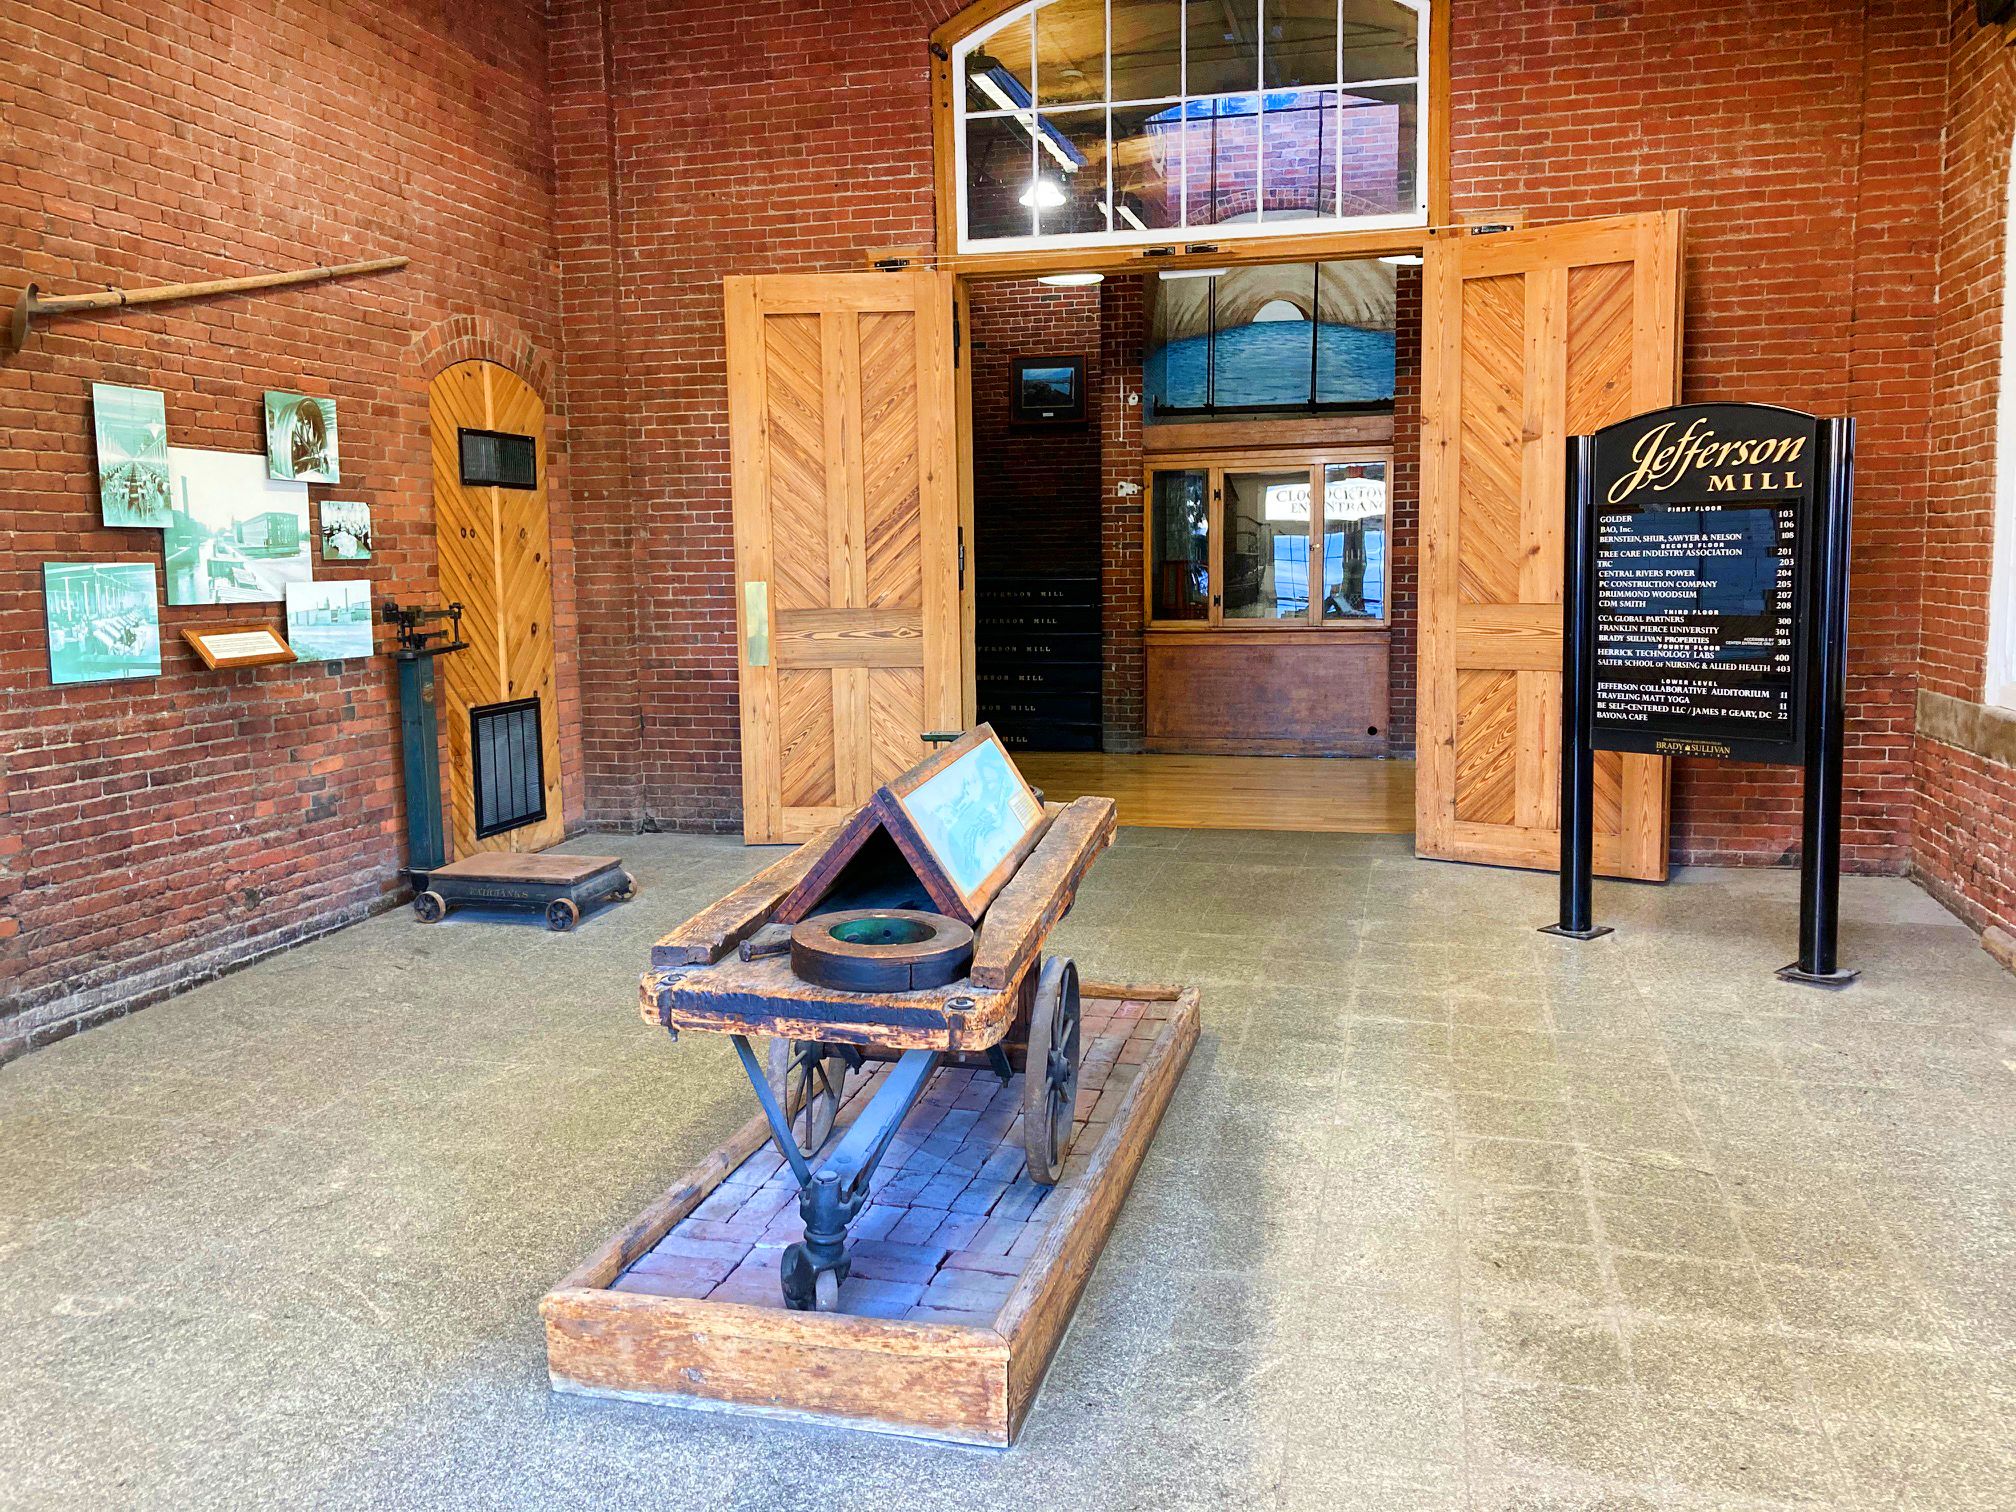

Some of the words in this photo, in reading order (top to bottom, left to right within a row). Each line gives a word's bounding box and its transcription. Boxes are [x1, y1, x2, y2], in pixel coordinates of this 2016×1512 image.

[1607, 417, 1807, 504] Jefferson
[1707, 471, 1803, 492] MILL
[1778, 510, 1794, 518] 103
[1600, 515, 1633, 523] GOLDER
[1779, 521, 1795, 529] 106
[1600, 526, 1619, 534] BAO,
[1643, 535, 1667, 543] SHUR,
[1668, 534, 1700, 542] SAWYER
[1701, 533, 1708, 541] &
[1781, 531, 1795, 539] 108
[1620, 550, 1641, 558] CARE
[1642, 549, 1684, 557] INDUSTRY
[1685, 548, 1743, 556] ASSOCIATION
[1777, 548, 1792, 556] 201
[1779, 558, 1795, 566] 203
[1665, 569, 1695, 577] POWER
[1776, 569, 1792, 577] 204
[1611, 580, 1675, 588] CONSTRUCTION
[1676, 580, 1718, 588] COMPANY
[1776, 580, 1792, 588] 205
[1599, 590, 1650, 598] DRUMMOND
[1652, 590, 1697, 599] WOODSUM
[1776, 591, 1793, 599] 207
[1619, 600, 1647, 608] SMITH
[1645, 615, 1685, 623] PARTNERS
[1777, 617, 1792, 625] 300
[1599, 624, 1638, 632] FRANKLIN
[1640, 625, 1668, 633] PIERCE
[1669, 626, 1720, 634] UNIVERSITY
[1775, 628, 1789, 636] 301
[1598, 634, 1624, 642] BRADY
[1626, 635, 1662, 643] SULLIVAN
[1664, 636, 1710, 644] PROPERTIES
[1777, 638, 1791, 646] 303
[1597, 648, 1633, 656] HERRICK
[1635, 649, 1691, 658] TECHNOLOGY
[1693, 651, 1715, 659] LABS
[1665, 661, 1700, 669] NURSING
[1701, 662, 1708, 670] &
[1709, 662, 1737, 670] ALLIED
[1738, 663, 1771, 672] HEALTH
[1597, 682, 1638, 691] JEFFERSON
[1640, 684, 1708, 695] COLLABORATIVE
[1711, 688, 1770, 698] AUDITORIUM
[1597, 692, 1640, 700] TRAVELING
[1641, 694, 1666, 702] MATT
[1667, 696, 1690, 704] YOGA
[1780, 691, 1788, 699] 11
[1597, 701, 1607, 709] BE
[1608, 702, 1669, 712] SELF-CENTERED
[1671, 705, 1687, 714] LLC
[1691, 707, 1719, 716] JAMES
[1728, 709, 1757, 719] GEARY,
[1758, 711, 1772, 719] DC
[1779, 702, 1787, 710] 11
[1596, 711, 1627, 720] BAYONA
[1628, 713, 1648, 721] CAFE
[1777, 712, 1788, 720] 22
[1656, 741, 1683, 750] BRADY
[1691, 744, 1731, 754] SULLIVAN
